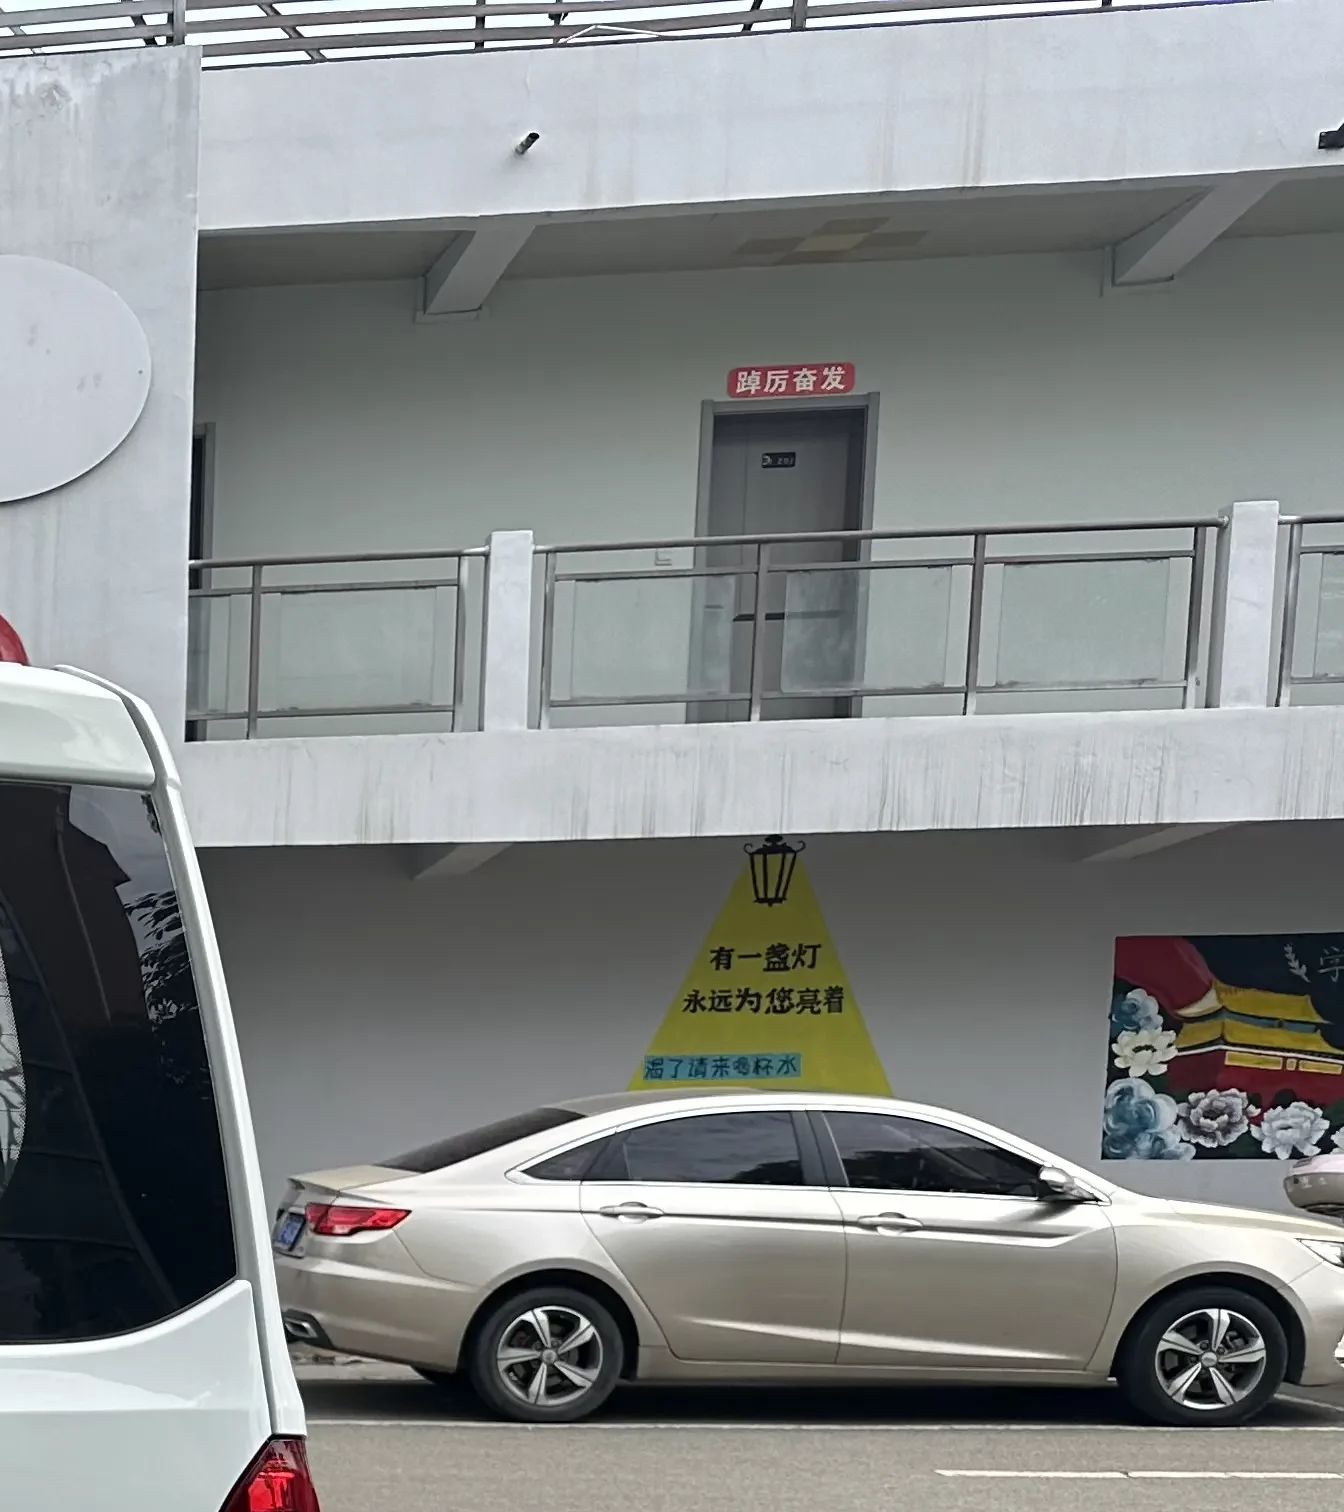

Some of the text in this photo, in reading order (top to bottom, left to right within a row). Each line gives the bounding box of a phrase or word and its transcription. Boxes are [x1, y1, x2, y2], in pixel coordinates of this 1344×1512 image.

[736, 366, 845, 394] 踔厉奋发
[710, 943, 822, 972] 有一盏灯
[683, 985, 845, 1014] 永远为您亮着
